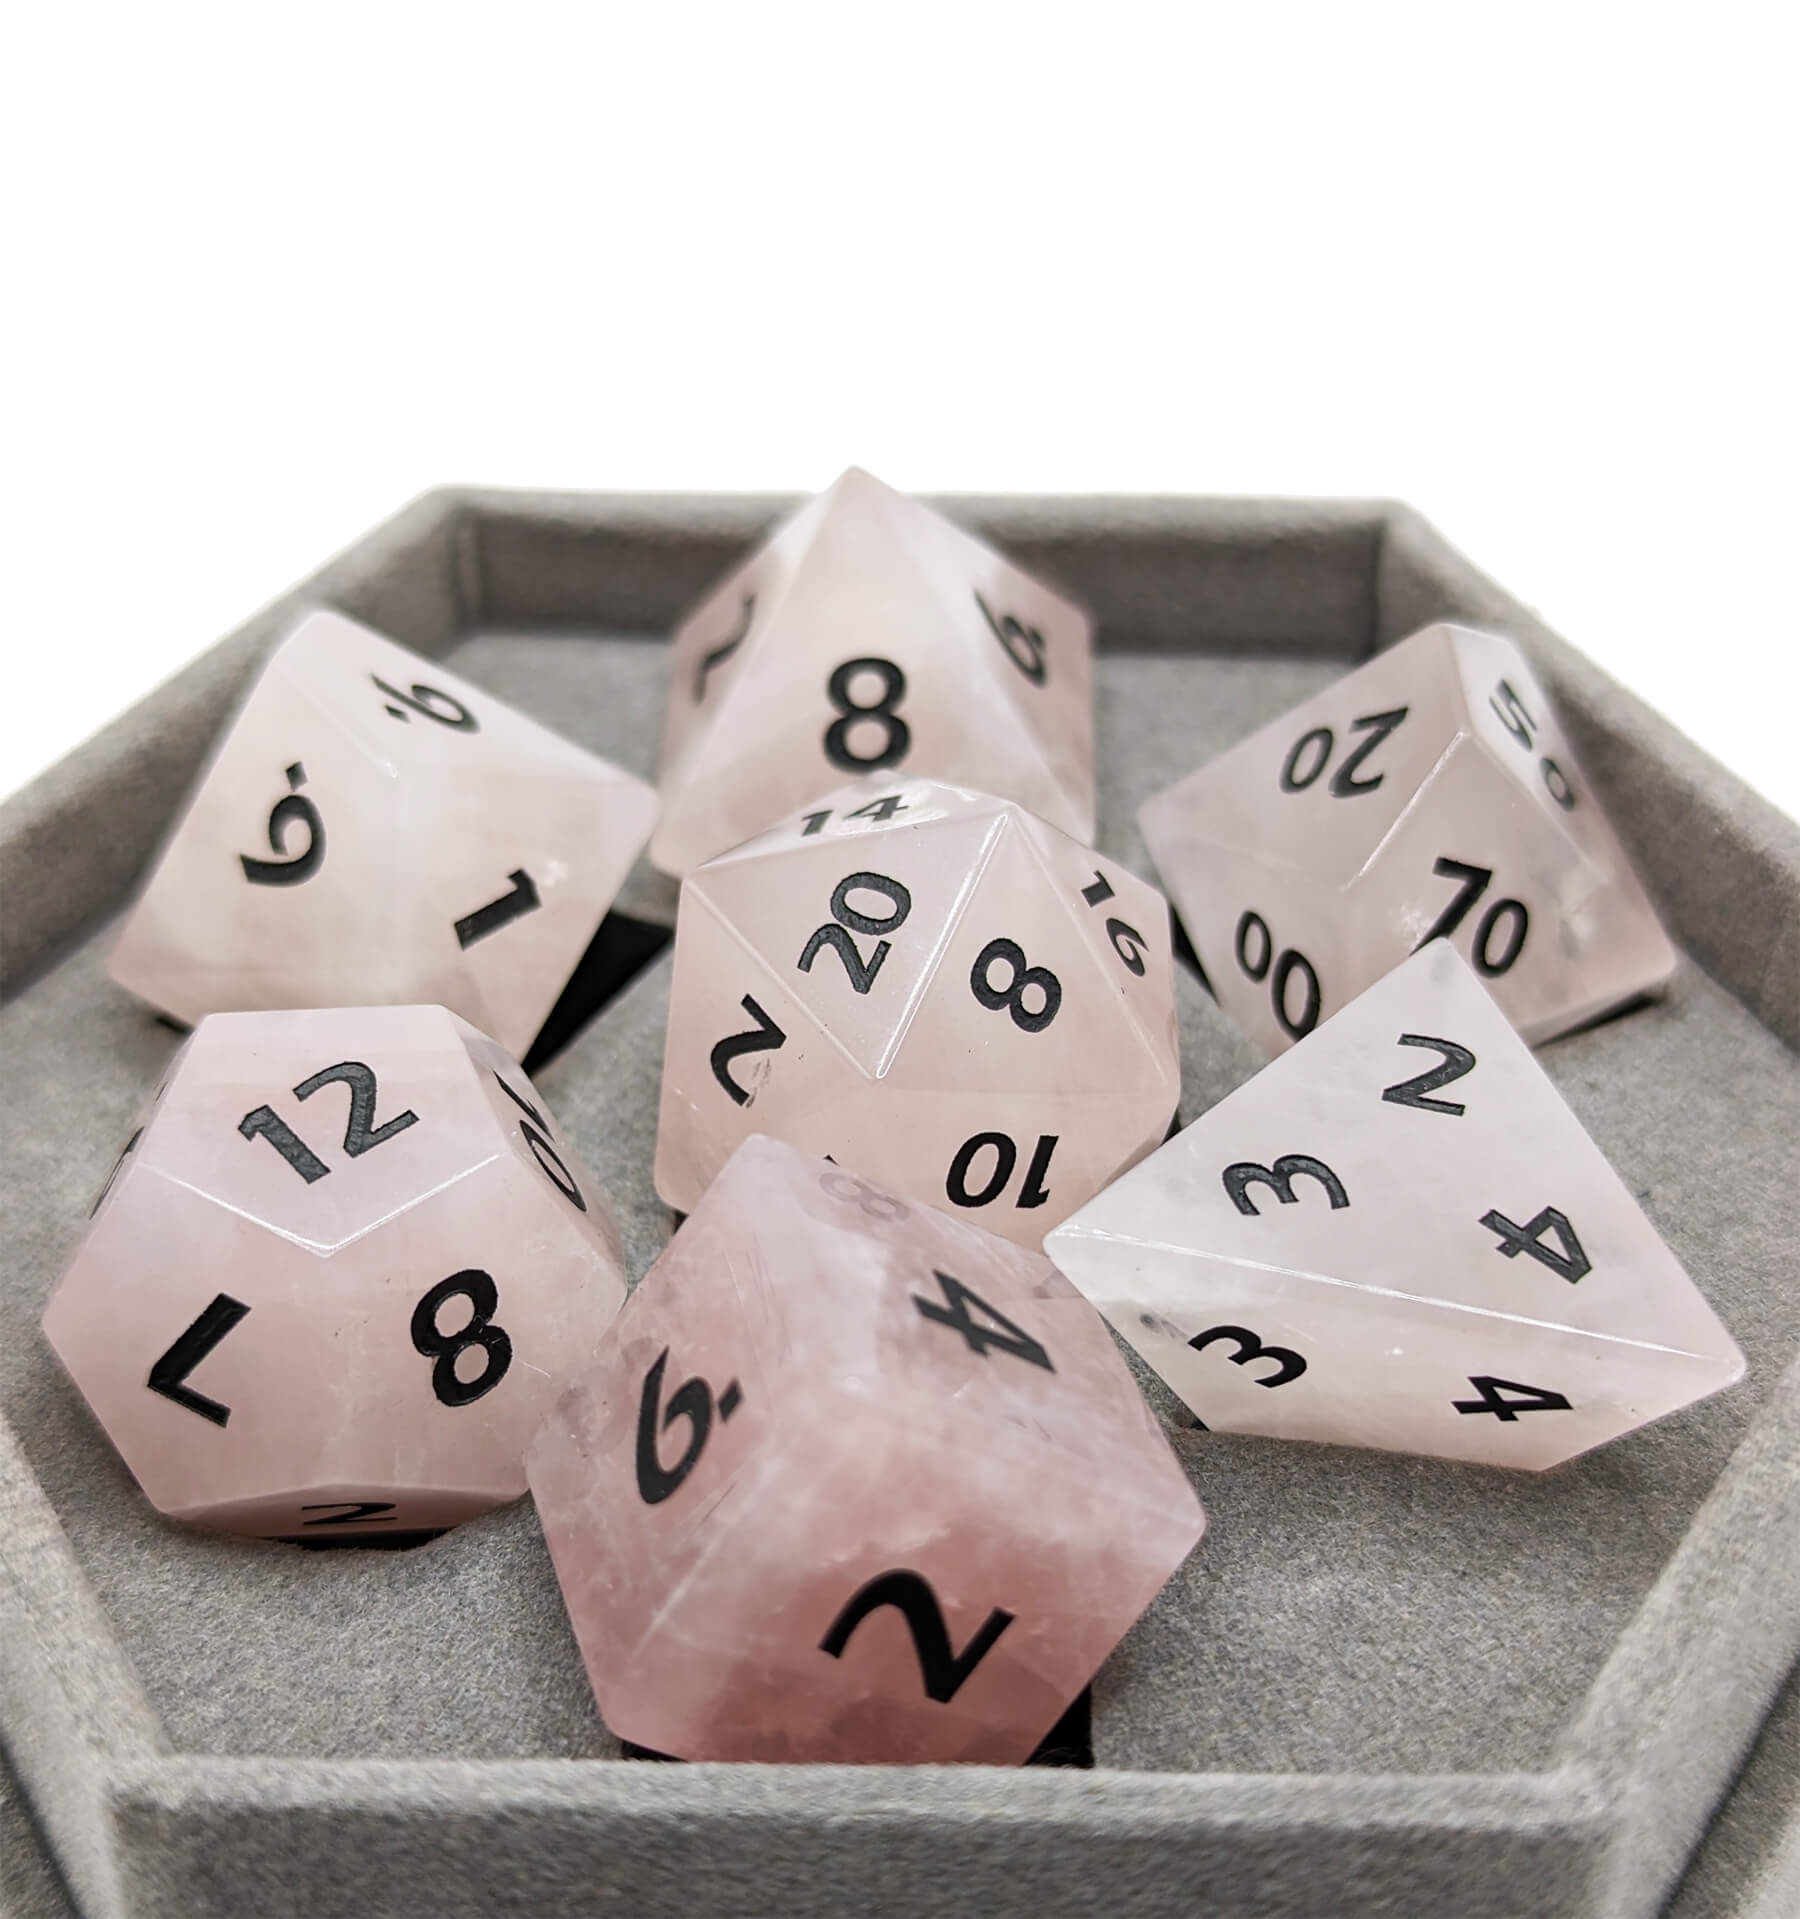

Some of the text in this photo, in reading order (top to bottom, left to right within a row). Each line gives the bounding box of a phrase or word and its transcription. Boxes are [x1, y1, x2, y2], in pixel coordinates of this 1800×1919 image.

[822, 656, 913, 774] 8
[1279, 705, 1411, 798] 20
[1489, 678, 1577, 812] 50
[799, 794, 909, 837] 14
[452, 868, 542, 950] 1
[796, 870, 913, 996] 20
[1080, 869, 1150, 978] 16
[1408, 855, 1529, 979] 70
[970, 936, 1063, 1034] 8
[1235, 910, 1323, 1045] 00
[709, 993, 788, 1108] 2
[1382, 1033, 1477, 1117] 2
[237, 1061, 420, 1185] 12
[945, 1132, 1060, 1209] 10
[1222, 1153, 1351, 1217] 3
[1479, 1206, 1594, 1285] 4
[145, 1293, 252, 1430] 7
[410, 1268, 514, 1409] 8
[911, 1269, 1056, 1374] 4
[1187, 1325, 1309, 1389] 3
[1451, 1375, 1574, 1423] 4
[301, 1502, 398, 1526] 2
[817, 1567, 1018, 1706] 2
